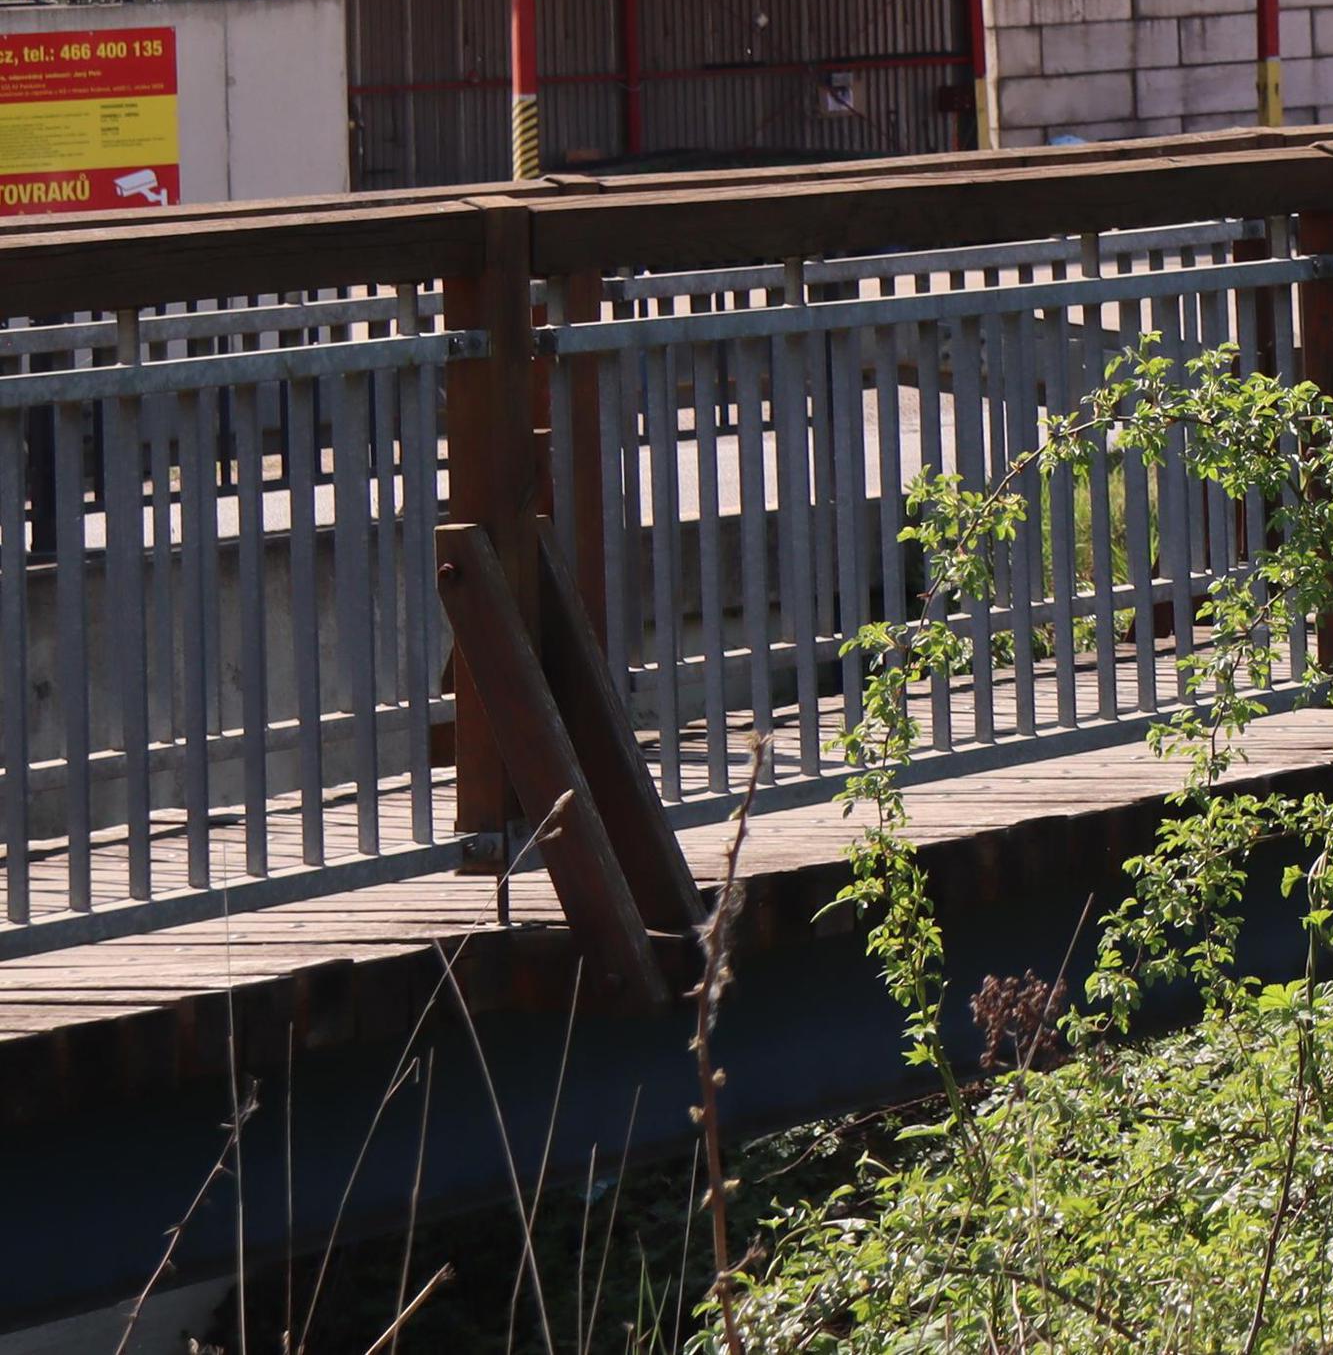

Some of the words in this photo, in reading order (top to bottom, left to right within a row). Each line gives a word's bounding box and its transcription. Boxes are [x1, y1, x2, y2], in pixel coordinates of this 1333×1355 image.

[23, 46, 55, 63] tel.:
[59, 44, 91, 60] 466
[96, 42, 127, 58] 400
[132, 40, 163, 57] 135
